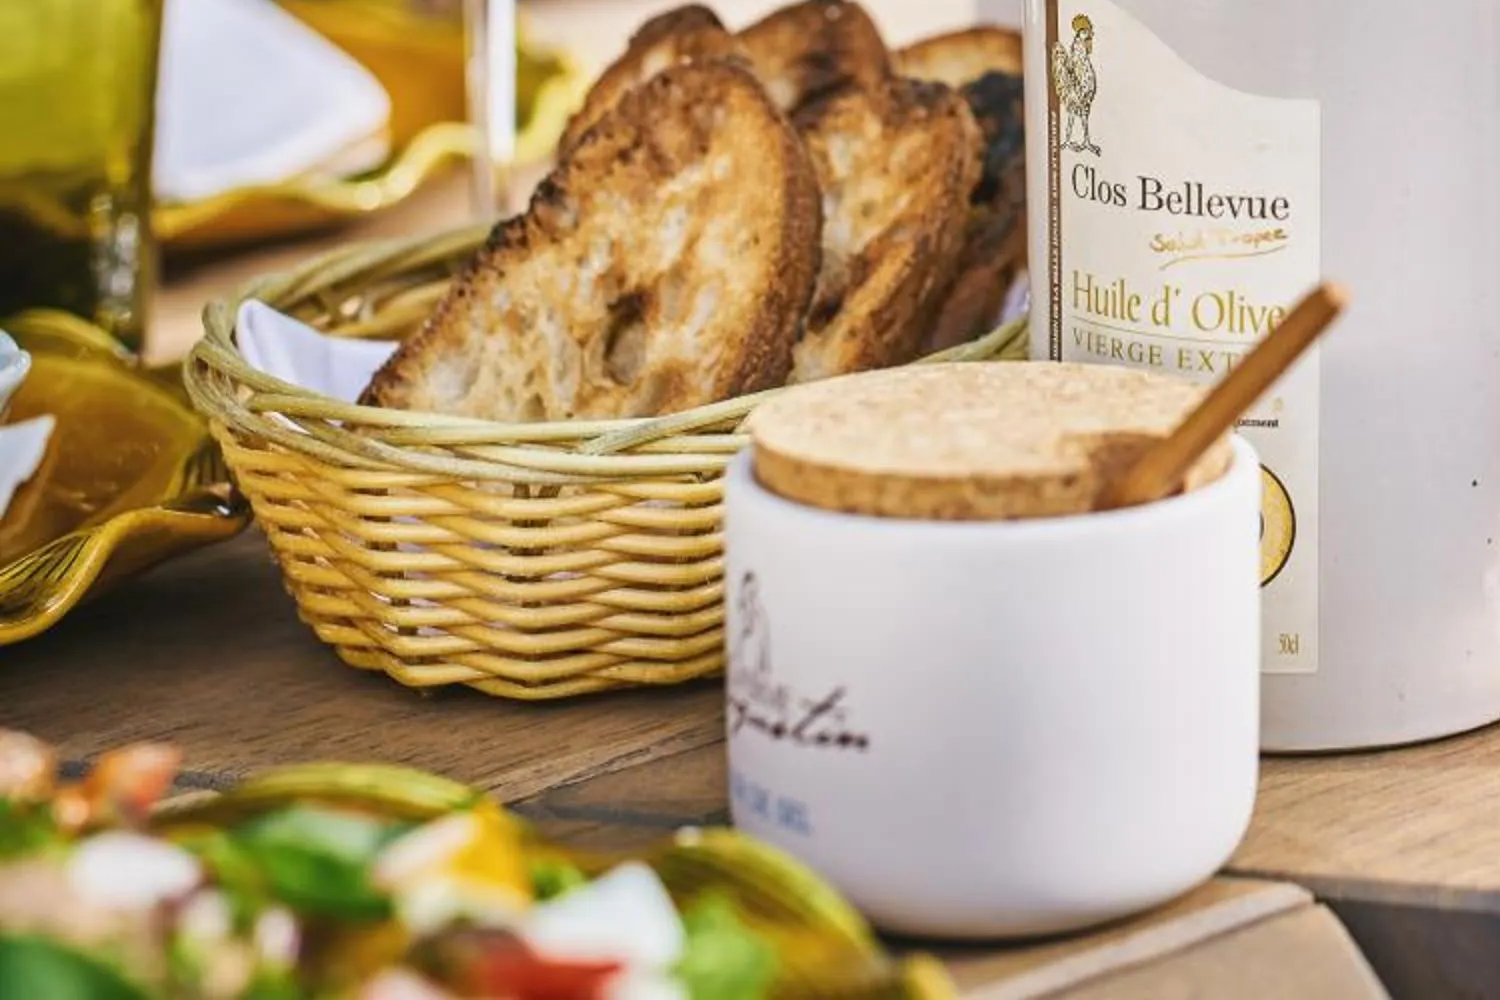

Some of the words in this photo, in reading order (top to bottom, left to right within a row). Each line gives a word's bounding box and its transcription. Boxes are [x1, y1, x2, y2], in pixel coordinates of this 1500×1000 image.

[1071, 163, 1127, 208] Clos
[1137, 175, 1290, 221] Bellevue
[1072, 270, 1141, 323] Huile
[1192, 290, 1286, 335] Olive
[1072, 327, 1163, 367] VIERGE
